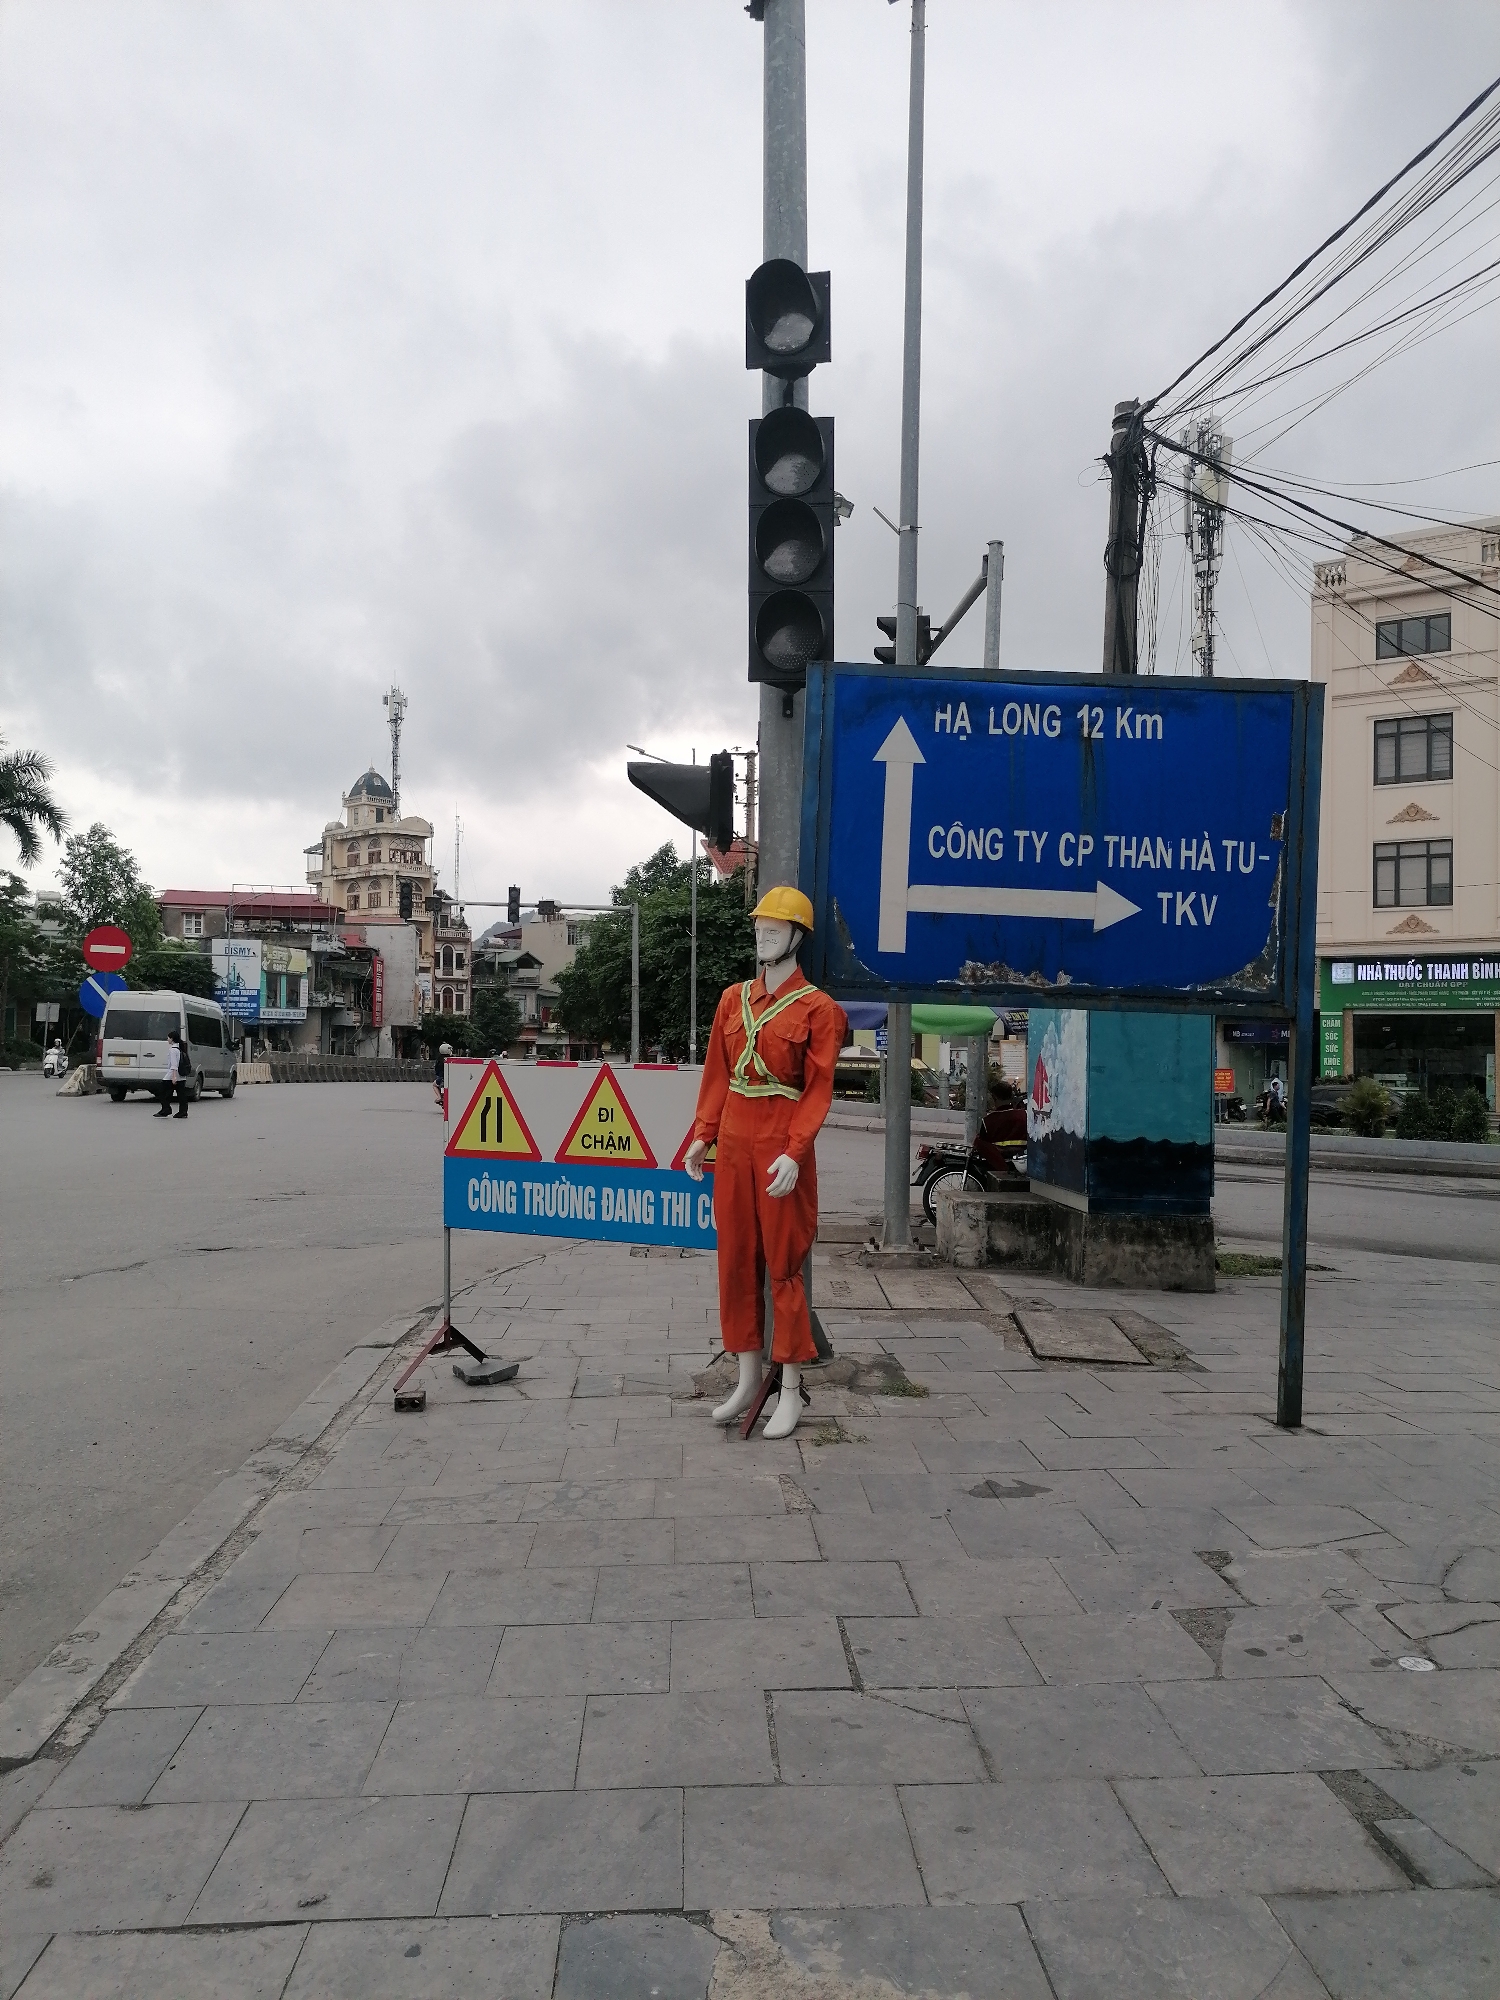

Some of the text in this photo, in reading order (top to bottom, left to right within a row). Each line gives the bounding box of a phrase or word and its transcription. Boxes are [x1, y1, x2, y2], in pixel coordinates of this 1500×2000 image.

[934, 701, 1163, 741] HẠ LONG 12 Km
[928, 821, 1004, 862] CÔNG
[1014, 830, 1049, 863] TY
[1058, 832, 1094, 867] CP
[1104, 836, 1173, 869] THAN
[1180, 831, 1215, 872] HÀ
[1157, 891, 1219, 927] TKV
[1357, 957, 1500, 981] NHÀ THUỐC THANH BÌNH
[1325, 1030, 1339, 1041] SÓC
[598, 1107, 614, 1123] ĐI
[581, 1131, 631, 1155] CHẬM
[467, 1171, 517, 1214] CÔNG
[523, 1175, 596, 1221] TRƯỜNG
[601, 1187, 655, 1225] ĐANG
[660, 1190, 691, 1228] THI
